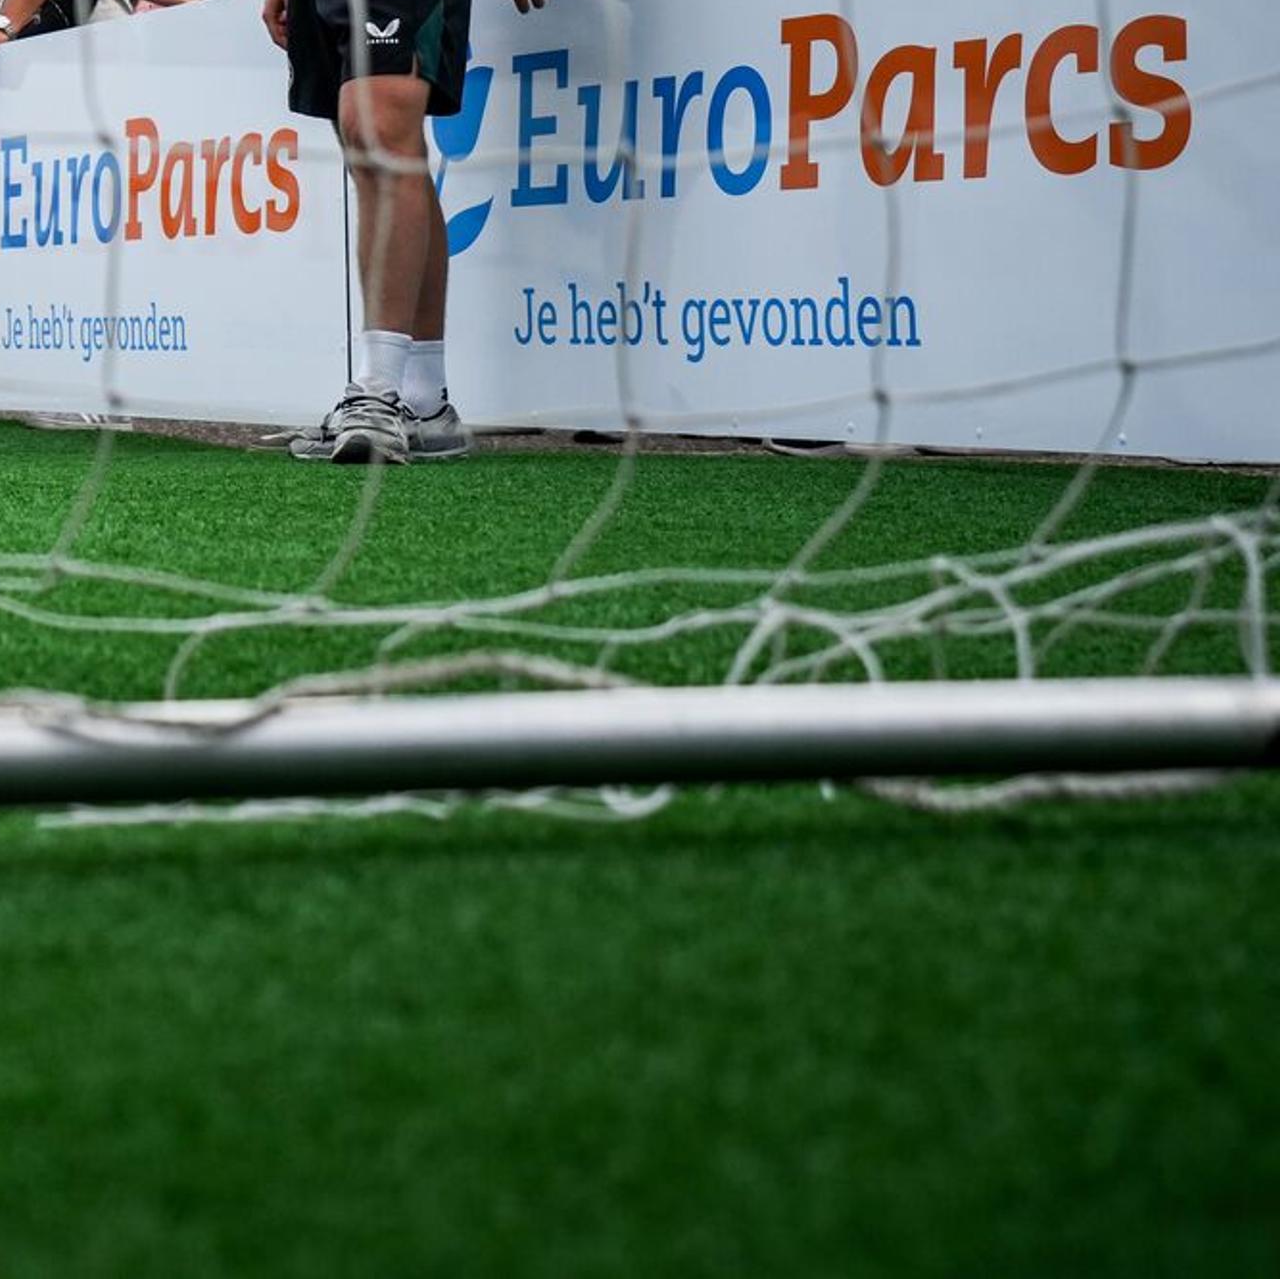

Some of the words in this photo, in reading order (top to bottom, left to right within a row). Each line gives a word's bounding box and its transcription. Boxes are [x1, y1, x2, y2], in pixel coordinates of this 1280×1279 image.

[510, 14, 1193, 208] EuroParcs
[0, 118, 301, 250] EuroParcs
[1, 306, 23, 350] Je
[80, 301, 188, 363] gevonden
[514, 288, 558, 347] Je
[568, 282, 669, 347] heb't
[682, 276, 922, 365] gevonden
